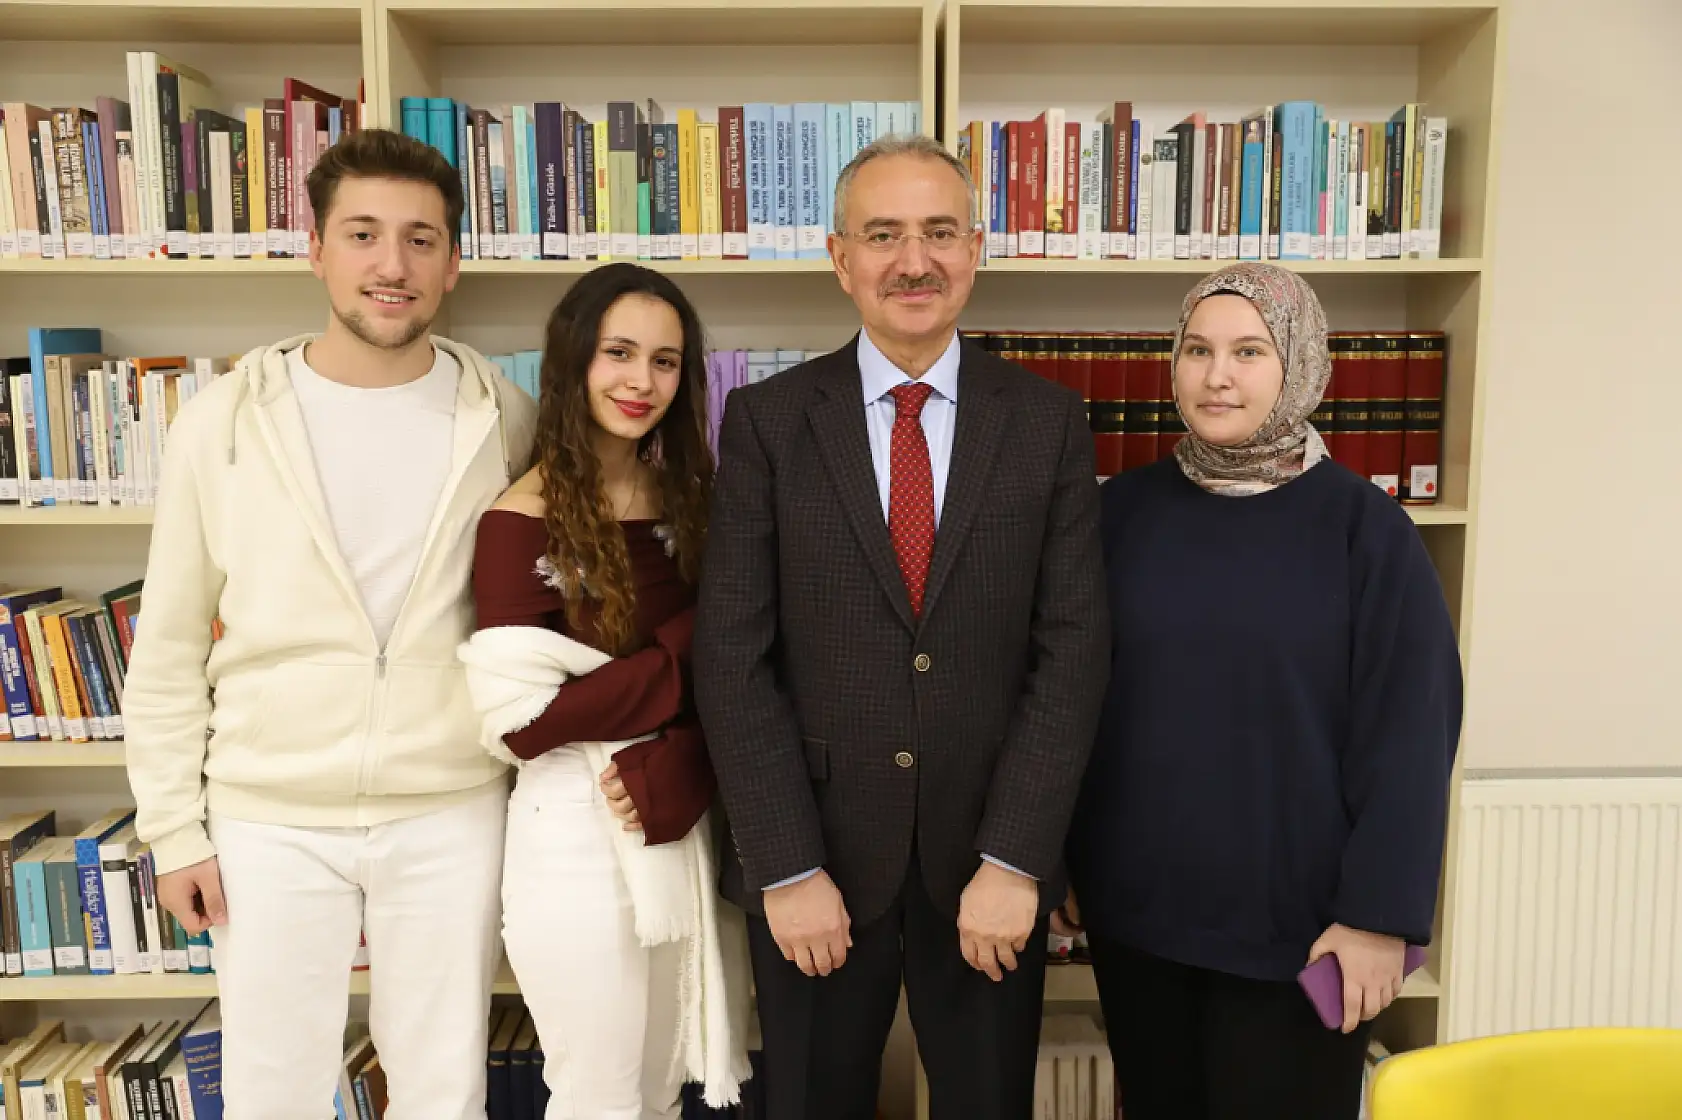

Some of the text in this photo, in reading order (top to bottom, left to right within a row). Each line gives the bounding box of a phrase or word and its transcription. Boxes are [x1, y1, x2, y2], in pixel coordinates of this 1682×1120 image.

[749, 121, 758, 160] KONGRESİ
[777, 121, 785, 160] KONGRESİ
[750, 163, 759, 185] TARİH
[777, 163, 785, 185] TARİH
[802, 163, 810, 185] TARİH
[751, 189, 760, 209] TÜRK
[803, 189, 811, 209] TÜRK
